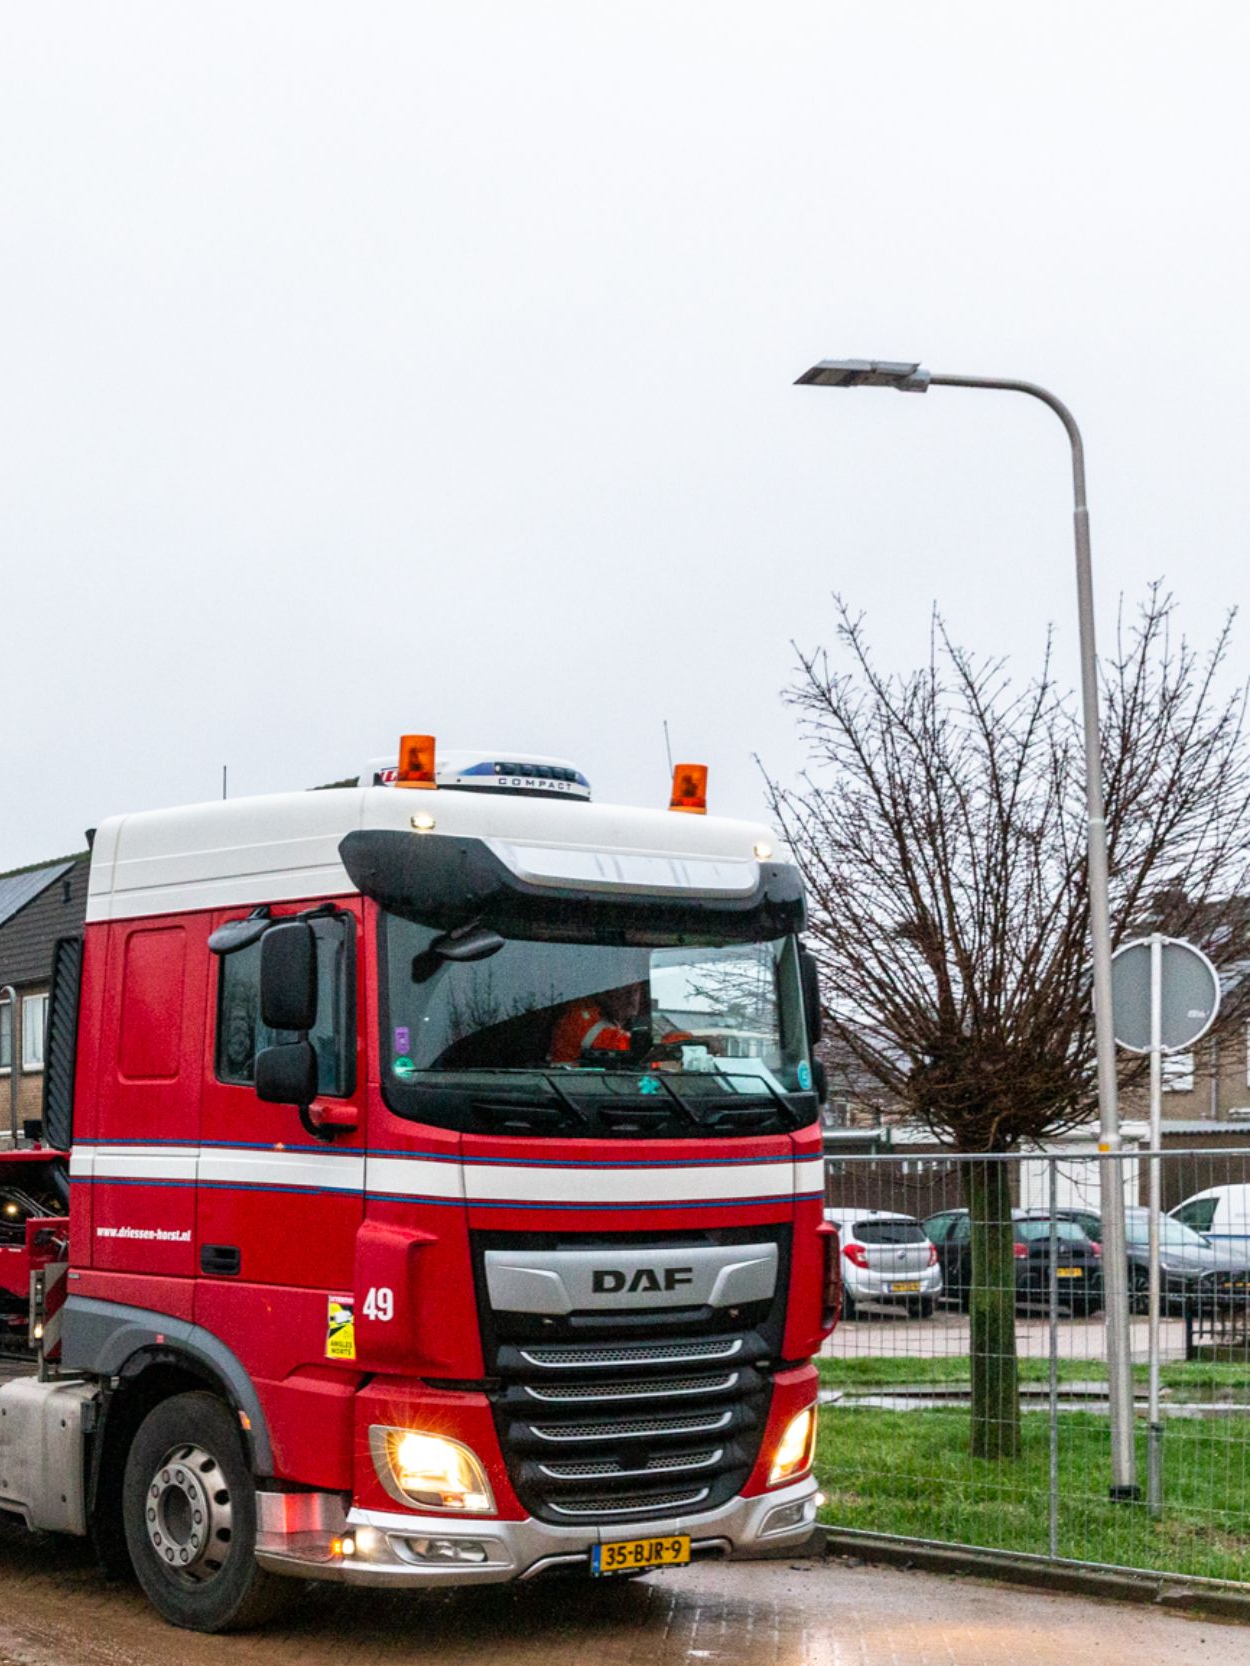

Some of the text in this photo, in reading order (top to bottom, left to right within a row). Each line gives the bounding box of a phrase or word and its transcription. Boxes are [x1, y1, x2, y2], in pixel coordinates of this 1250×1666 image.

[498, 777, 572, 790] COMPACT
[96, 1226, 192, 1242] www.driessen-horst.nl
[592, 1267, 693, 1293] DAF
[362, 1287, 393, 1322] 49
[605, 1540, 682, 1566] 35-BJR-9
